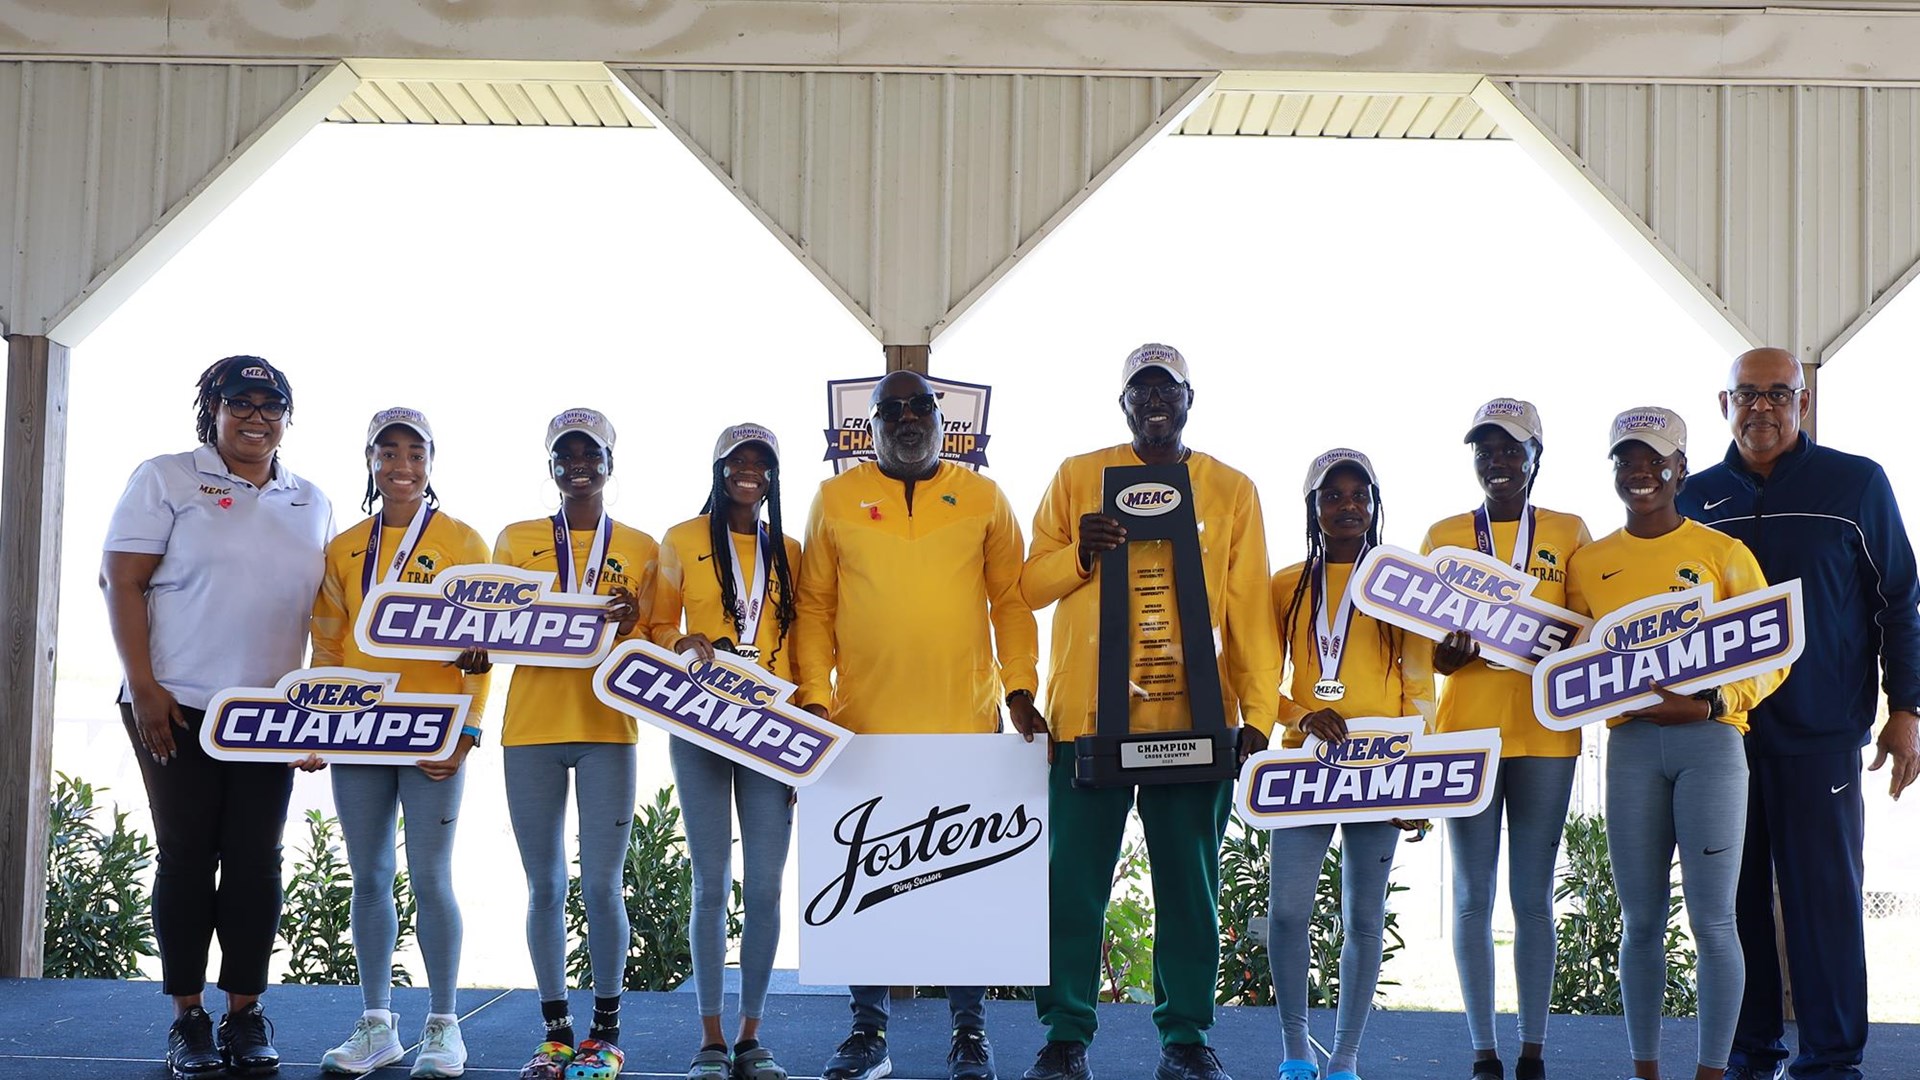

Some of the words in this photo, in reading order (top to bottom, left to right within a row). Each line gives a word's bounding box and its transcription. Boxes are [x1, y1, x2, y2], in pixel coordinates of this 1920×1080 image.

[199, 484, 231, 495] MEAC
[1126, 490, 1174, 506] MEAC
[451, 579, 539, 606] MEAC
[601, 571, 629, 585] RACK
[1442, 560, 1521, 601] MEAC
[377, 603, 599, 648] CHAMPS
[1370, 564, 1568, 656] CHAMPS
[1612, 600, 1699, 649] MEAC
[738, 649, 760, 658] EAC
[1554, 609, 1781, 710] CHAMPS
[298, 683, 384, 707] MEAC
[692, 660, 777, 706] MEAC
[1315, 685, 1344, 694] MEAC
[222, 708, 443, 747] CHAMPS
[614, 659, 821, 767] CHAMPS
[1137, 742, 1197, 753] CHAMPION
[1324, 733, 1409, 764] MEAC
[1257, 760, 1475, 806] CHAMPS
[804, 796, 1043, 926] Jostens
[892, 882, 912, 893] Ring
[913, 872, 942, 887] Season
